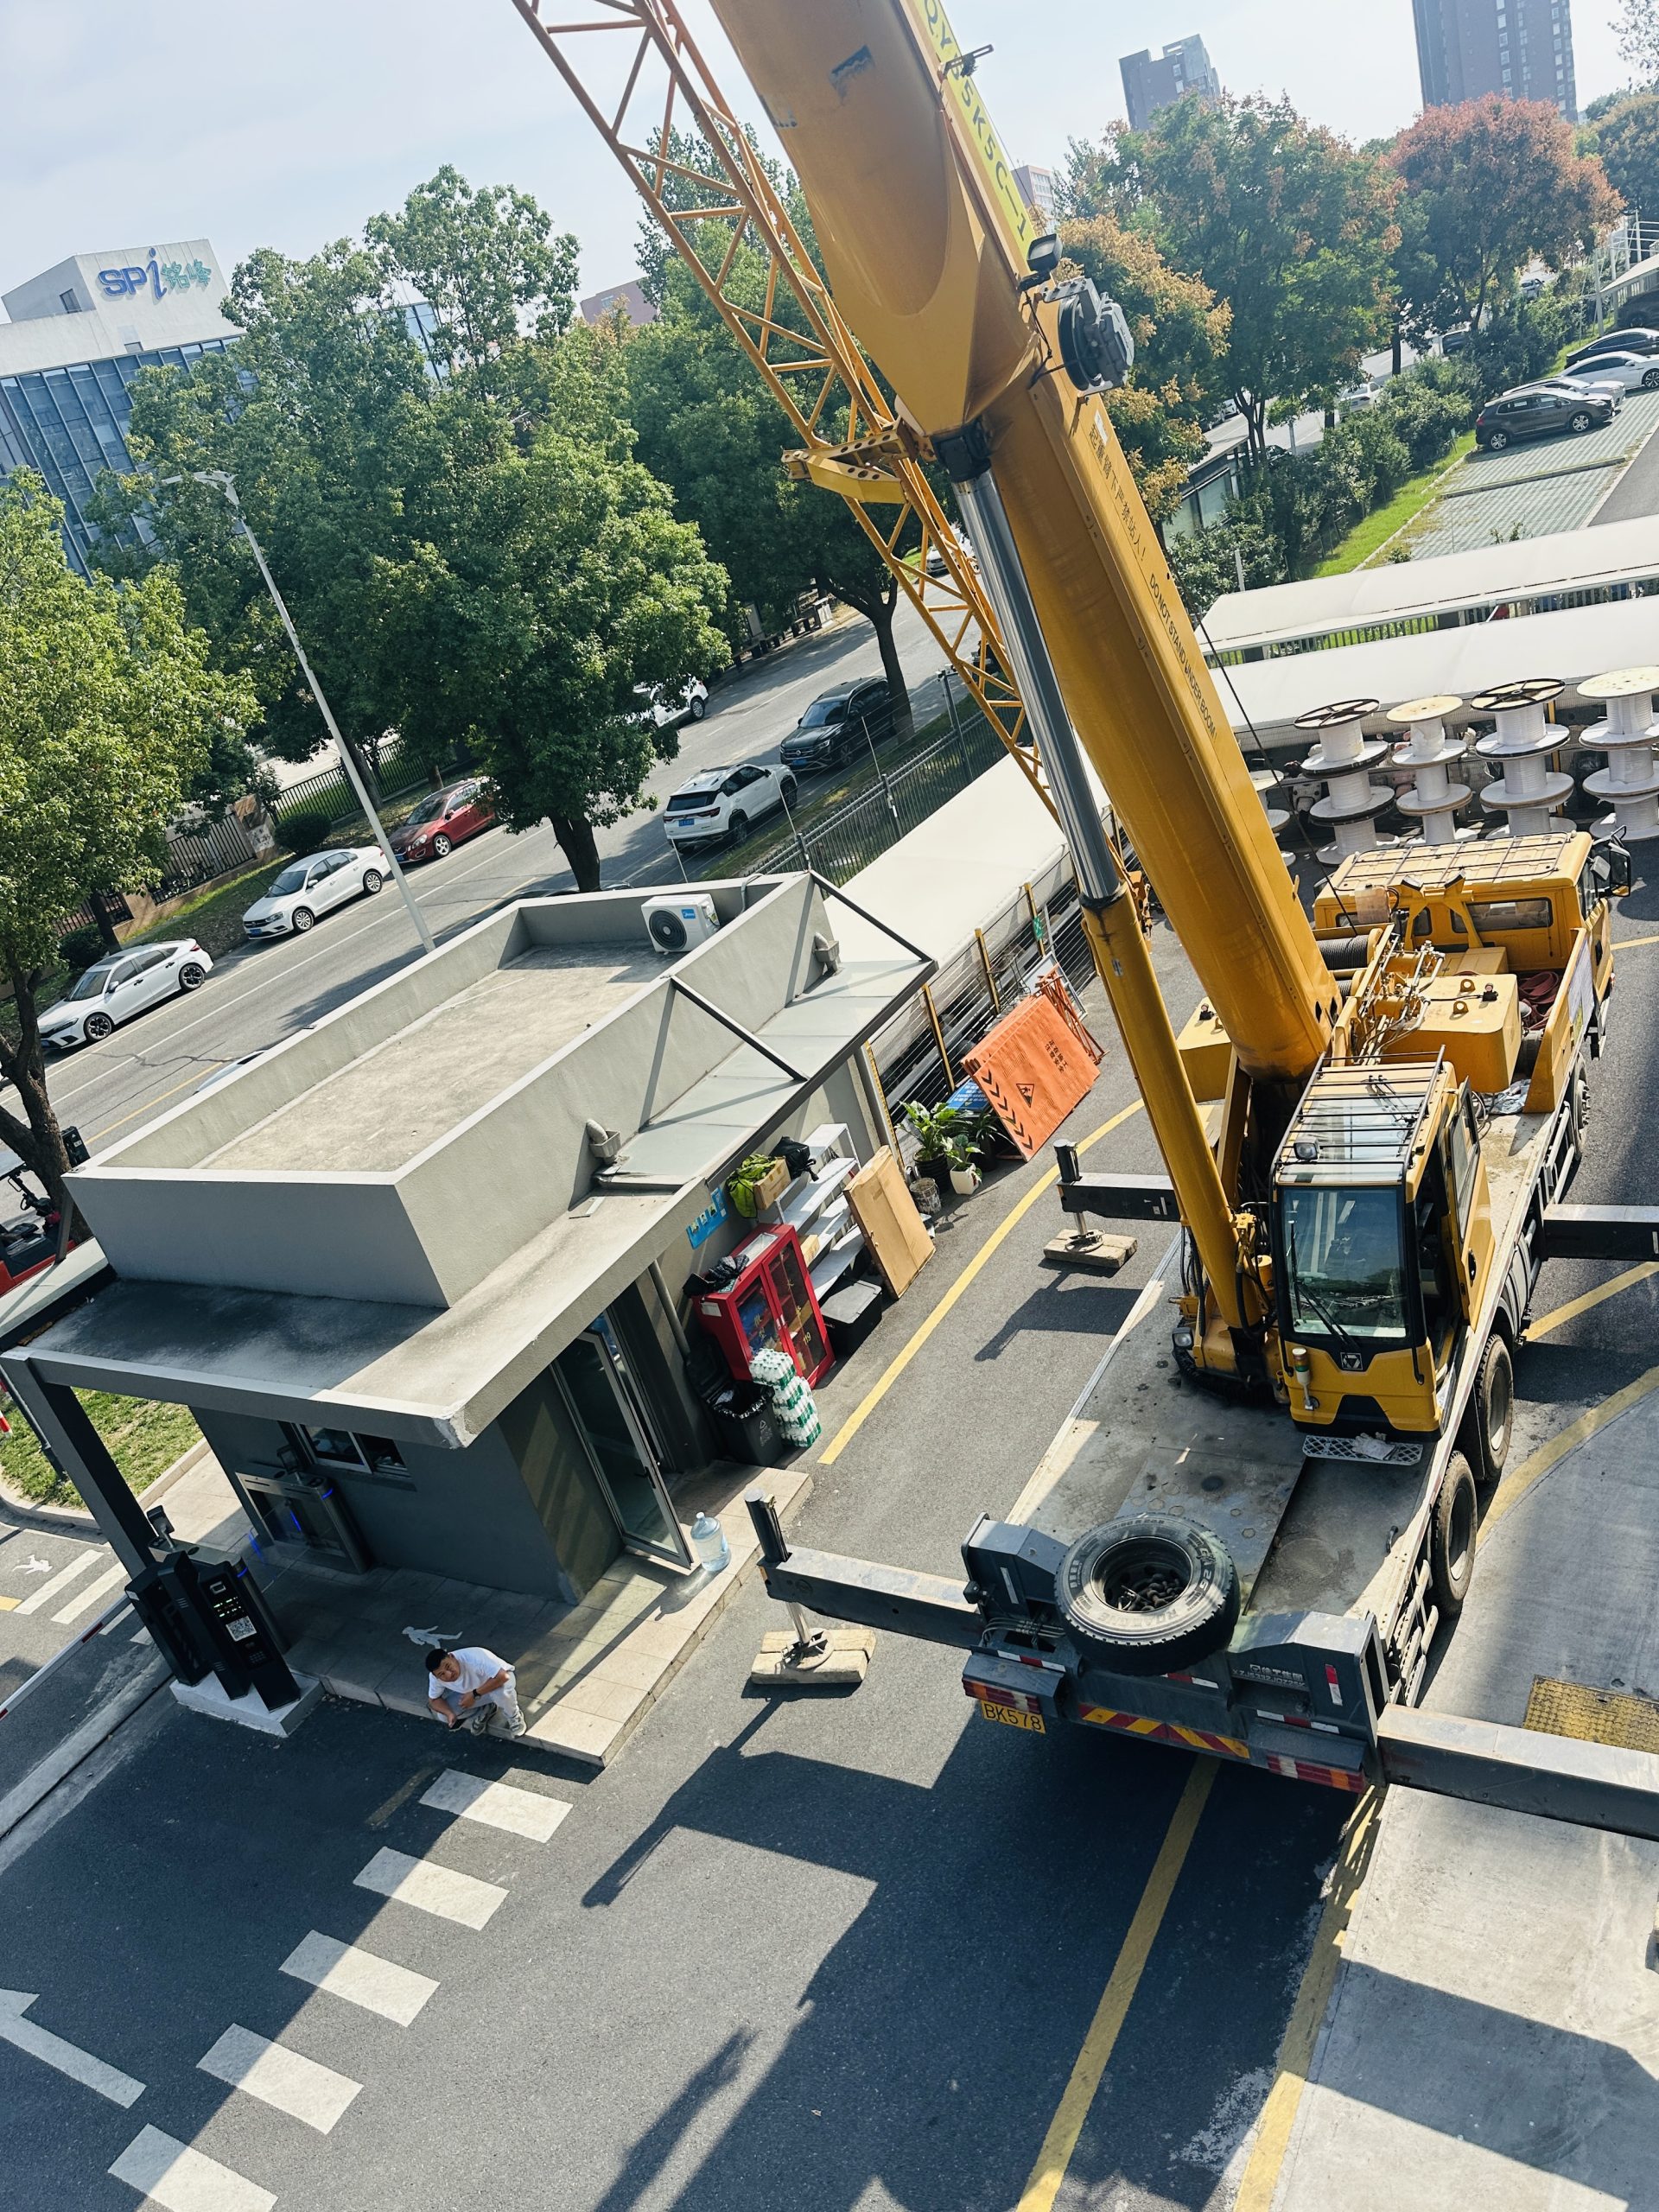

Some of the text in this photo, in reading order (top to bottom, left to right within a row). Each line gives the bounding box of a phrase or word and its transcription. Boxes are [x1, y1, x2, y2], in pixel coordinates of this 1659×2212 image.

[160, 258, 212, 289] 铭峰
[1149, 573, 1160, 599] DO
[1158, 596, 1169, 624] NOT
[1168, 620, 1186, 666] STAND
[1185, 658, 1202, 704] UNDER
[803, 1332, 812, 1346] 119
[983, 1703, 1042, 1731] BK578
